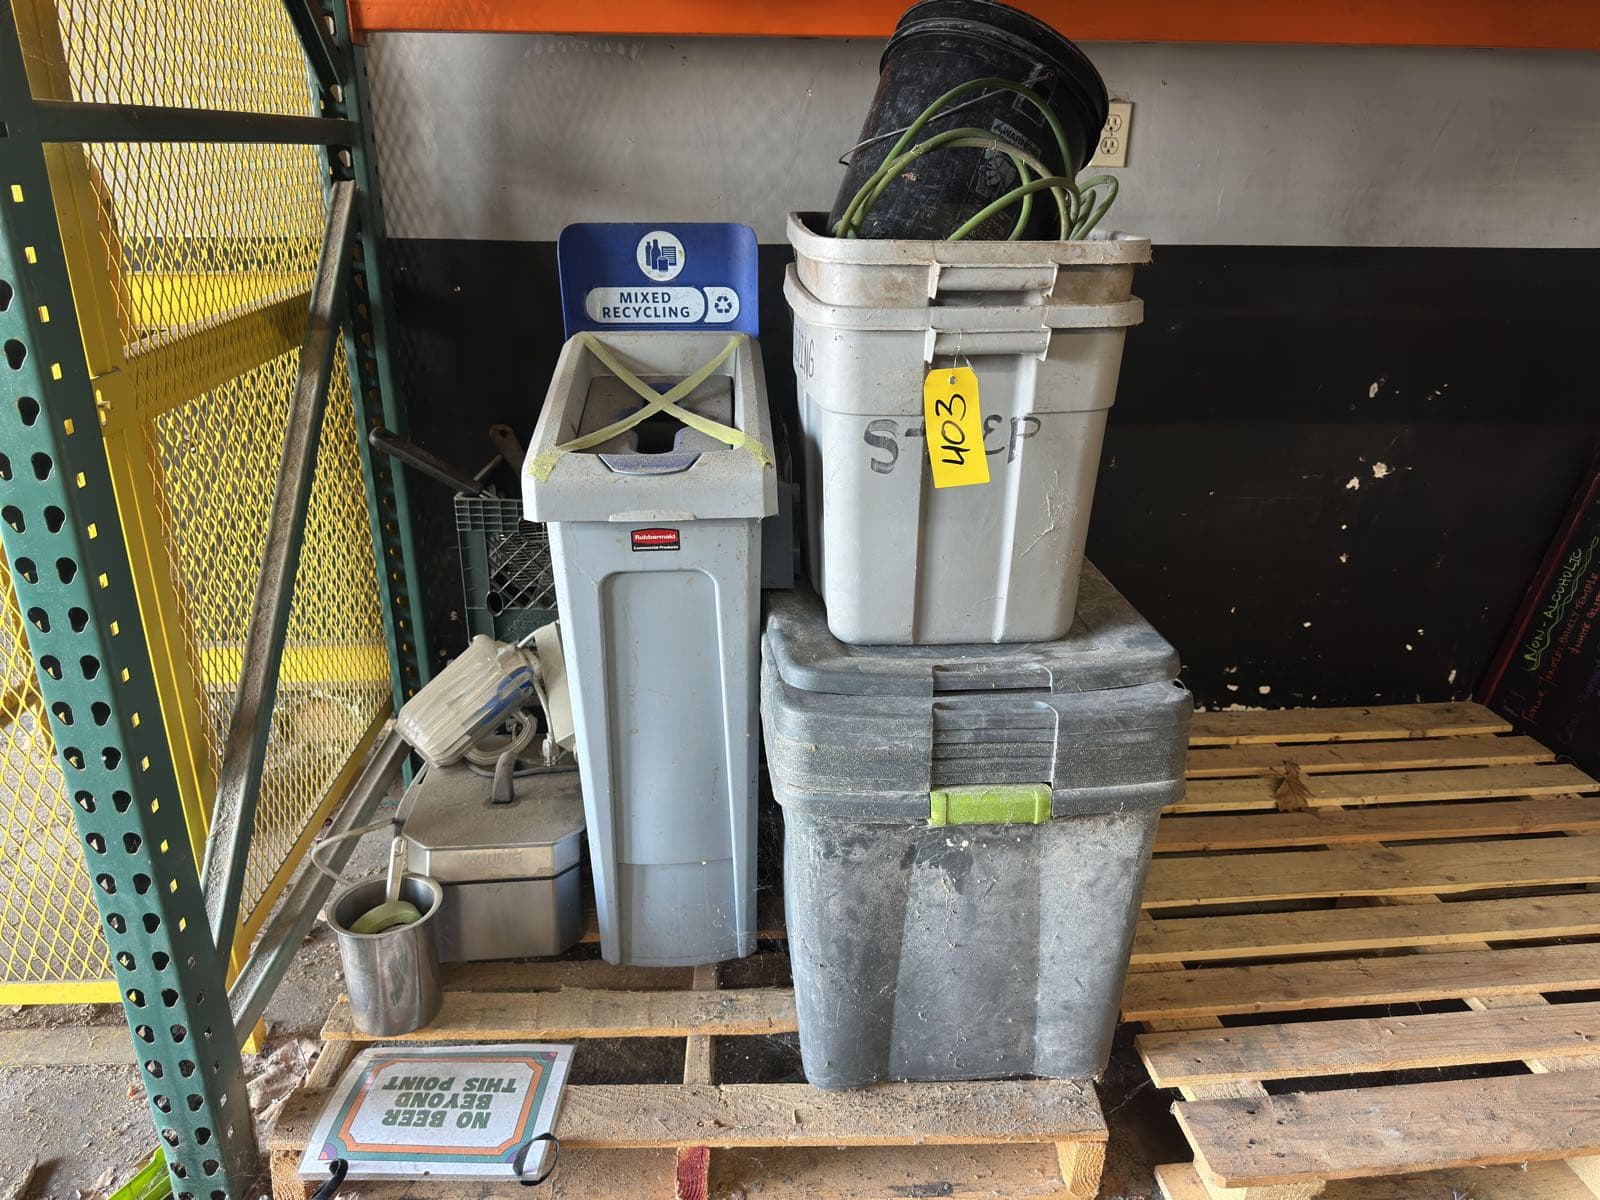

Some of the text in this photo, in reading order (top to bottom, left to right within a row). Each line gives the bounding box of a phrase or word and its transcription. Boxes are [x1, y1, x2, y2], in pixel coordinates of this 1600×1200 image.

[620, 292, 671, 303] MIXED
[603, 306, 690, 318] RECYCLING
[935, 393, 971, 466] 403
[382, 1076, 517, 1093] THIS POINT
[394, 1092, 493, 1109] BEYOND
[381, 1109, 492, 1129] NO BEER
